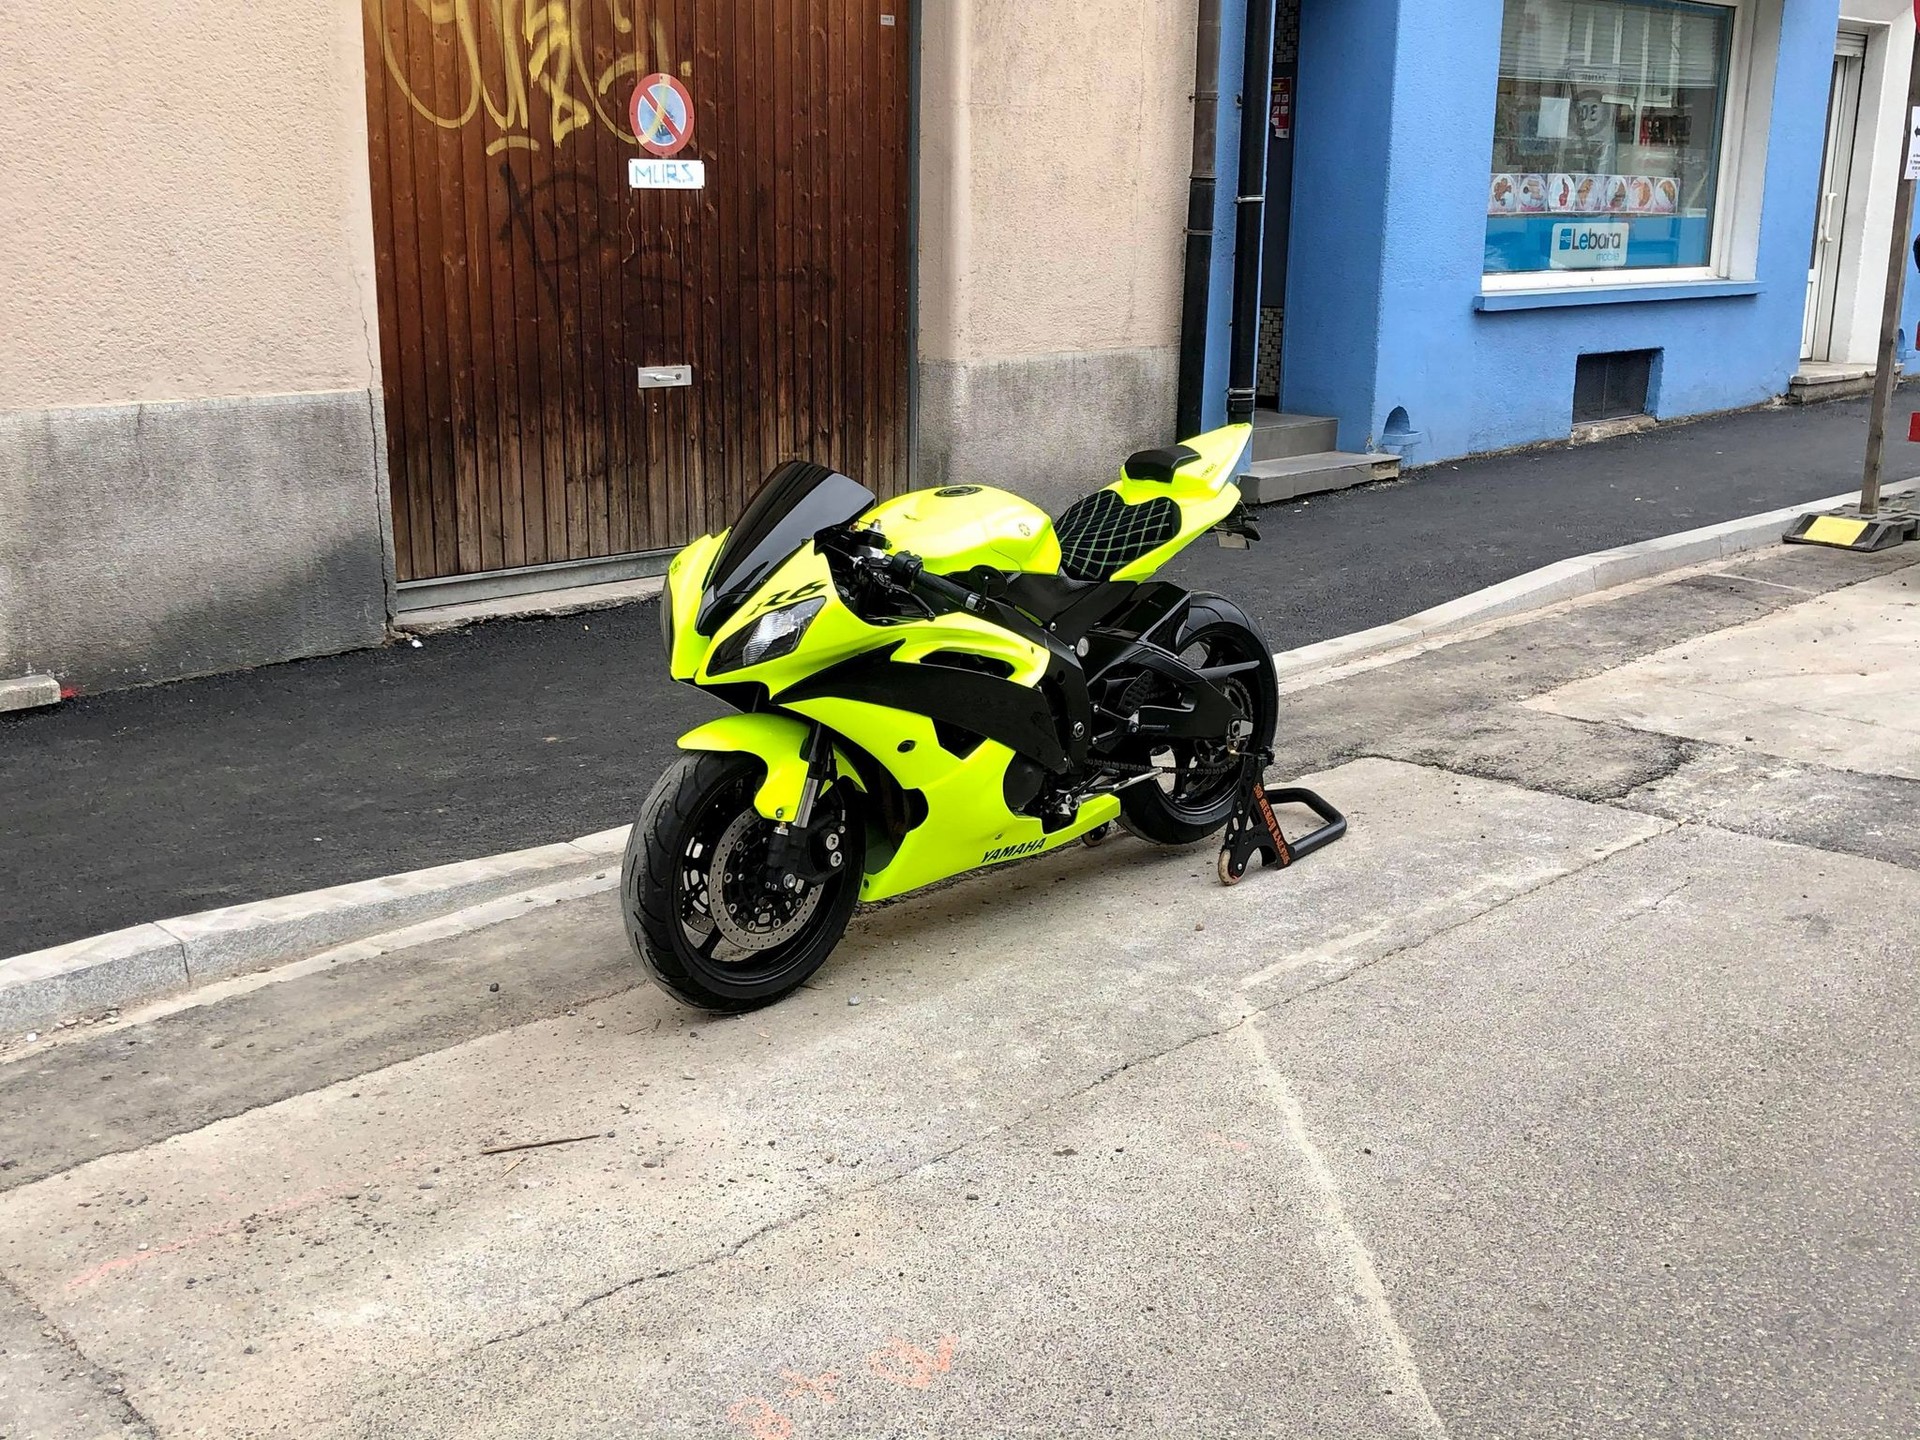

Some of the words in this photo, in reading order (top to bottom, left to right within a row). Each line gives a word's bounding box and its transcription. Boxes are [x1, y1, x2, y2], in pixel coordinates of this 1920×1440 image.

[635, 163, 694, 184] MURS
[1572, 228, 1621, 250] Lebara
[981, 837, 1047, 863] YAMAHA
